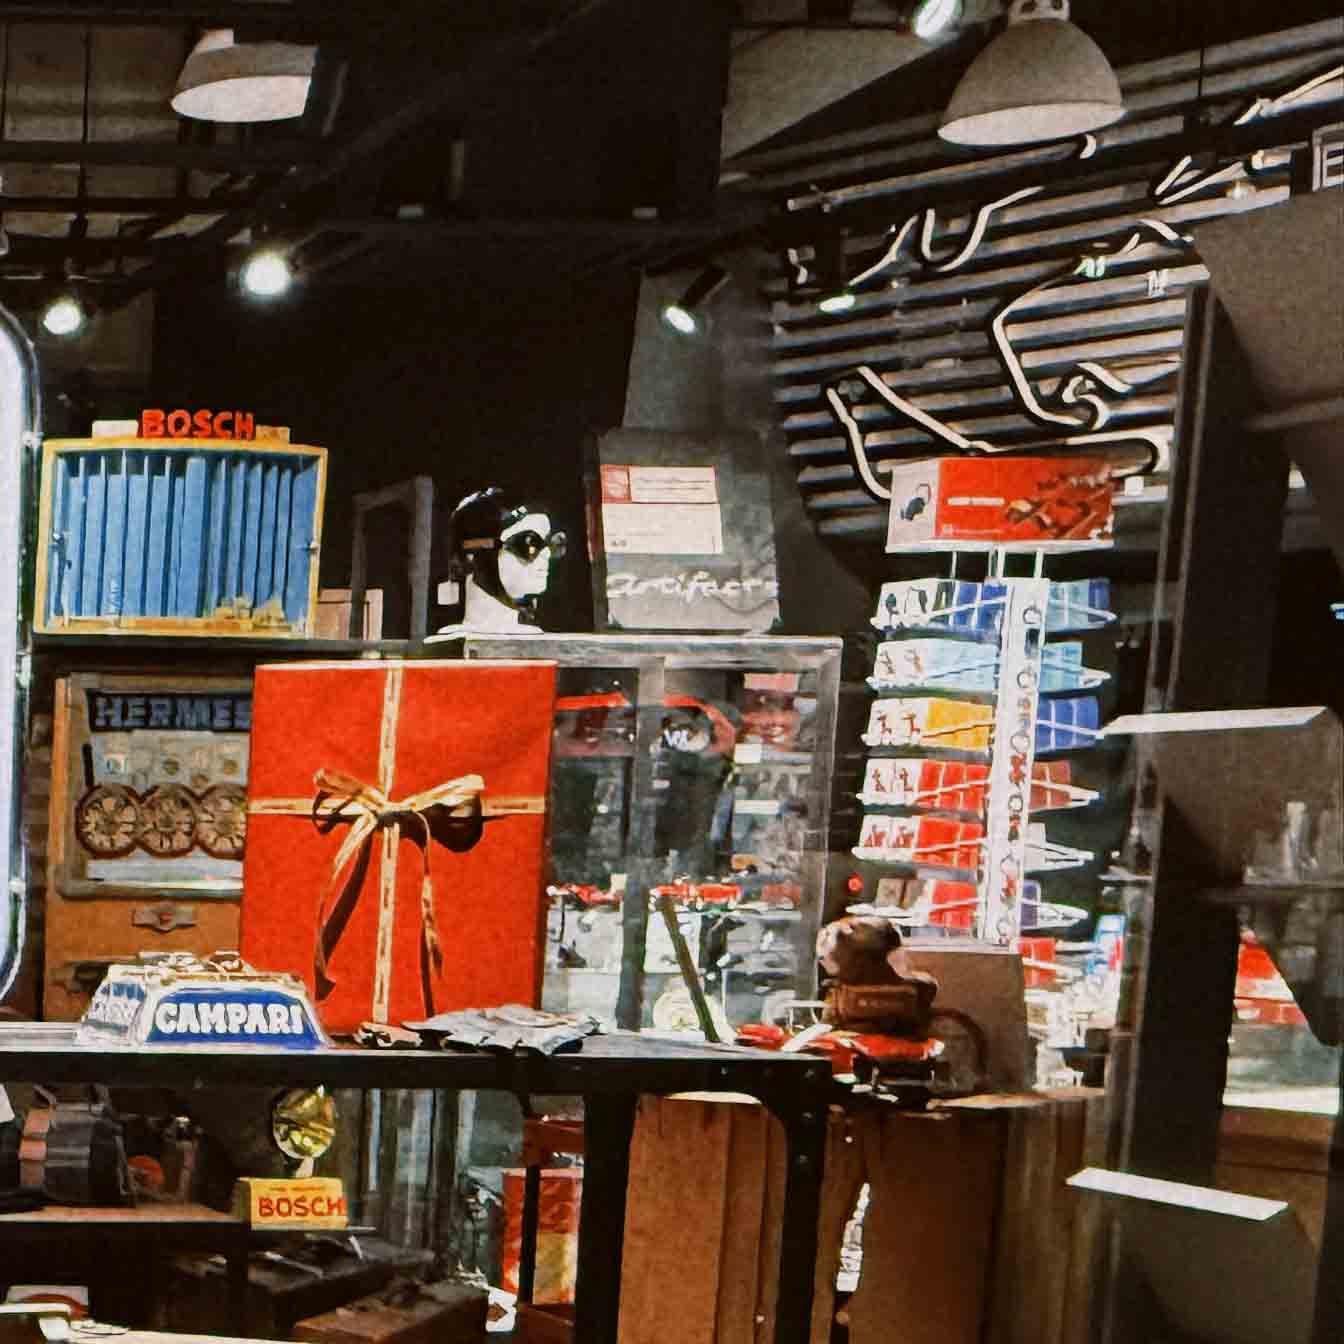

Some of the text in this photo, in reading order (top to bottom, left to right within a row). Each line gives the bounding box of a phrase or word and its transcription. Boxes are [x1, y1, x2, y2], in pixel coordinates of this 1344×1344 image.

[142, 408, 254, 440] BOSCH
[155, 1002, 305, 1035] CAMPARI
[258, 1195, 349, 1217] BOSCH
